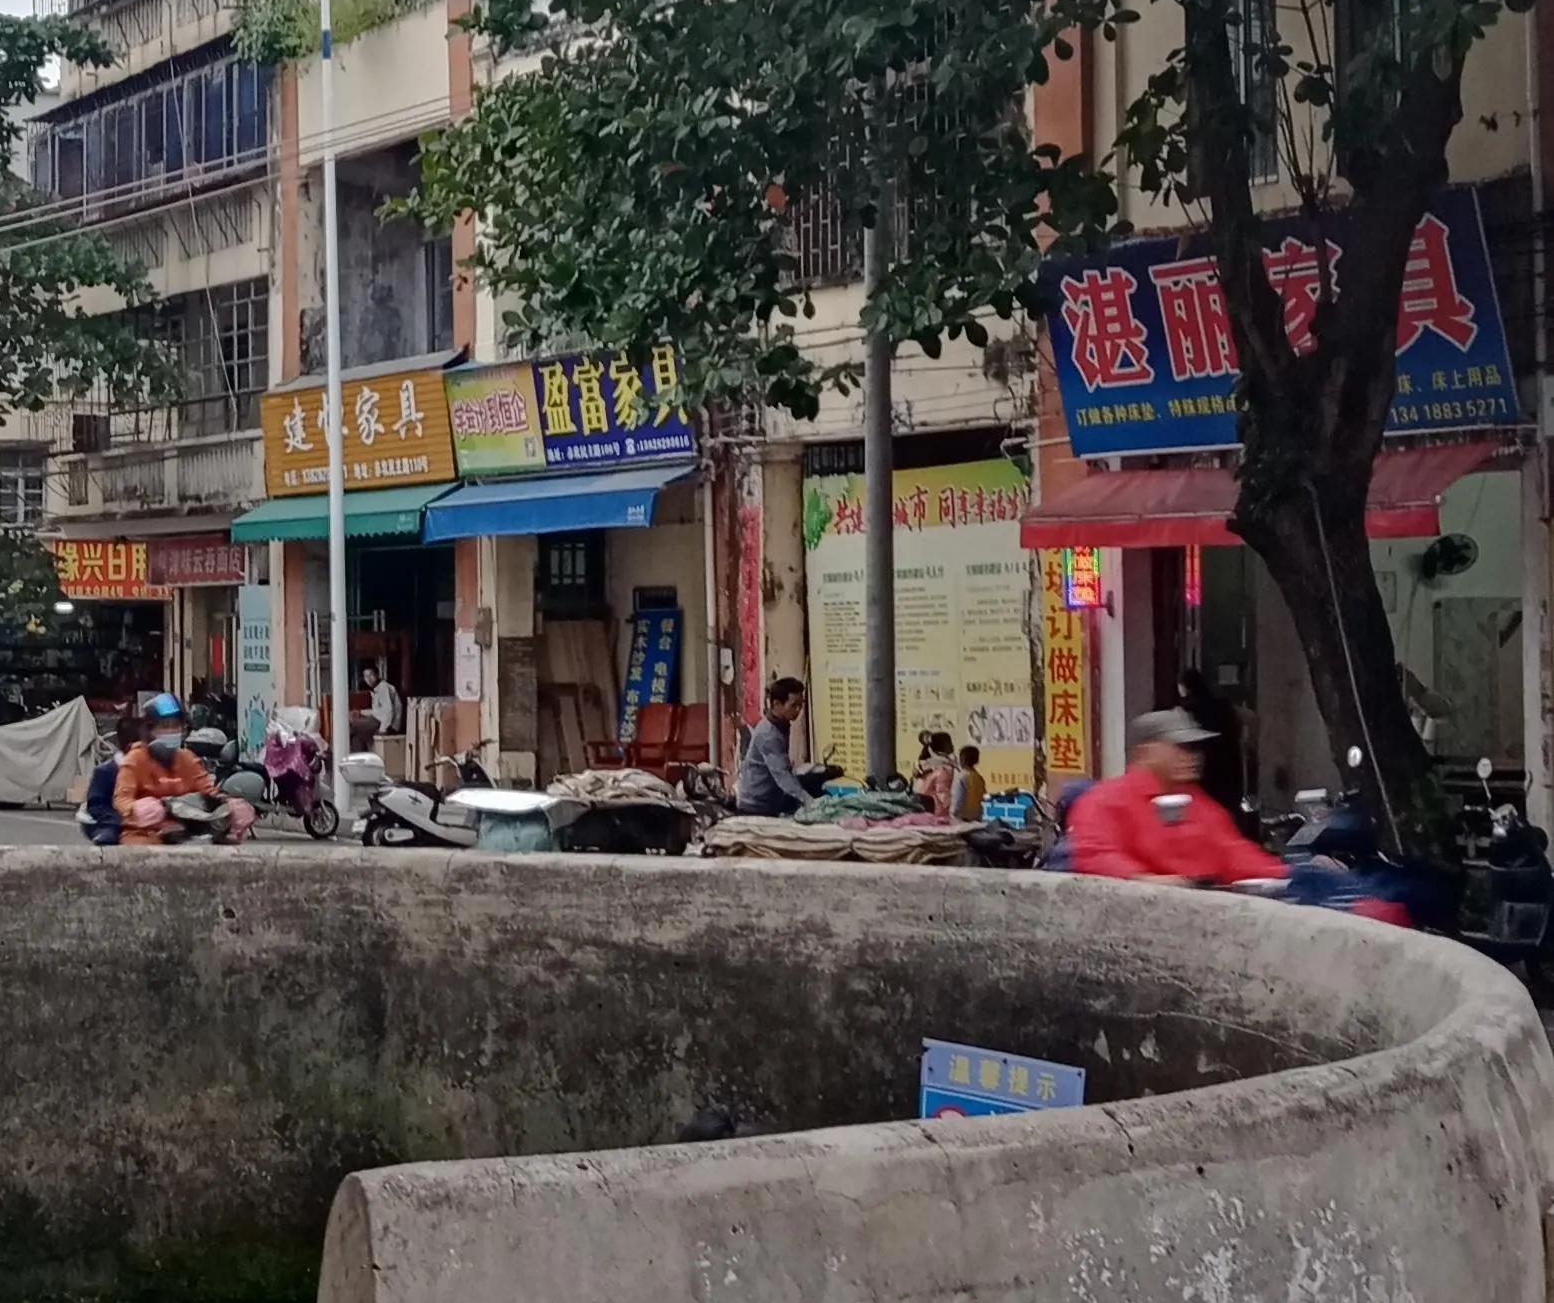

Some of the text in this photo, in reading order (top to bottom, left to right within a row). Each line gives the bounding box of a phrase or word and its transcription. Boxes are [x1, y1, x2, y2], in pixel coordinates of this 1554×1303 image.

[539, 344, 688, 436] 盈富家具
[1390, 397, 1507, 425] 134 1883 5271
[949, 1054, 1057, 1101] 温馨提示
